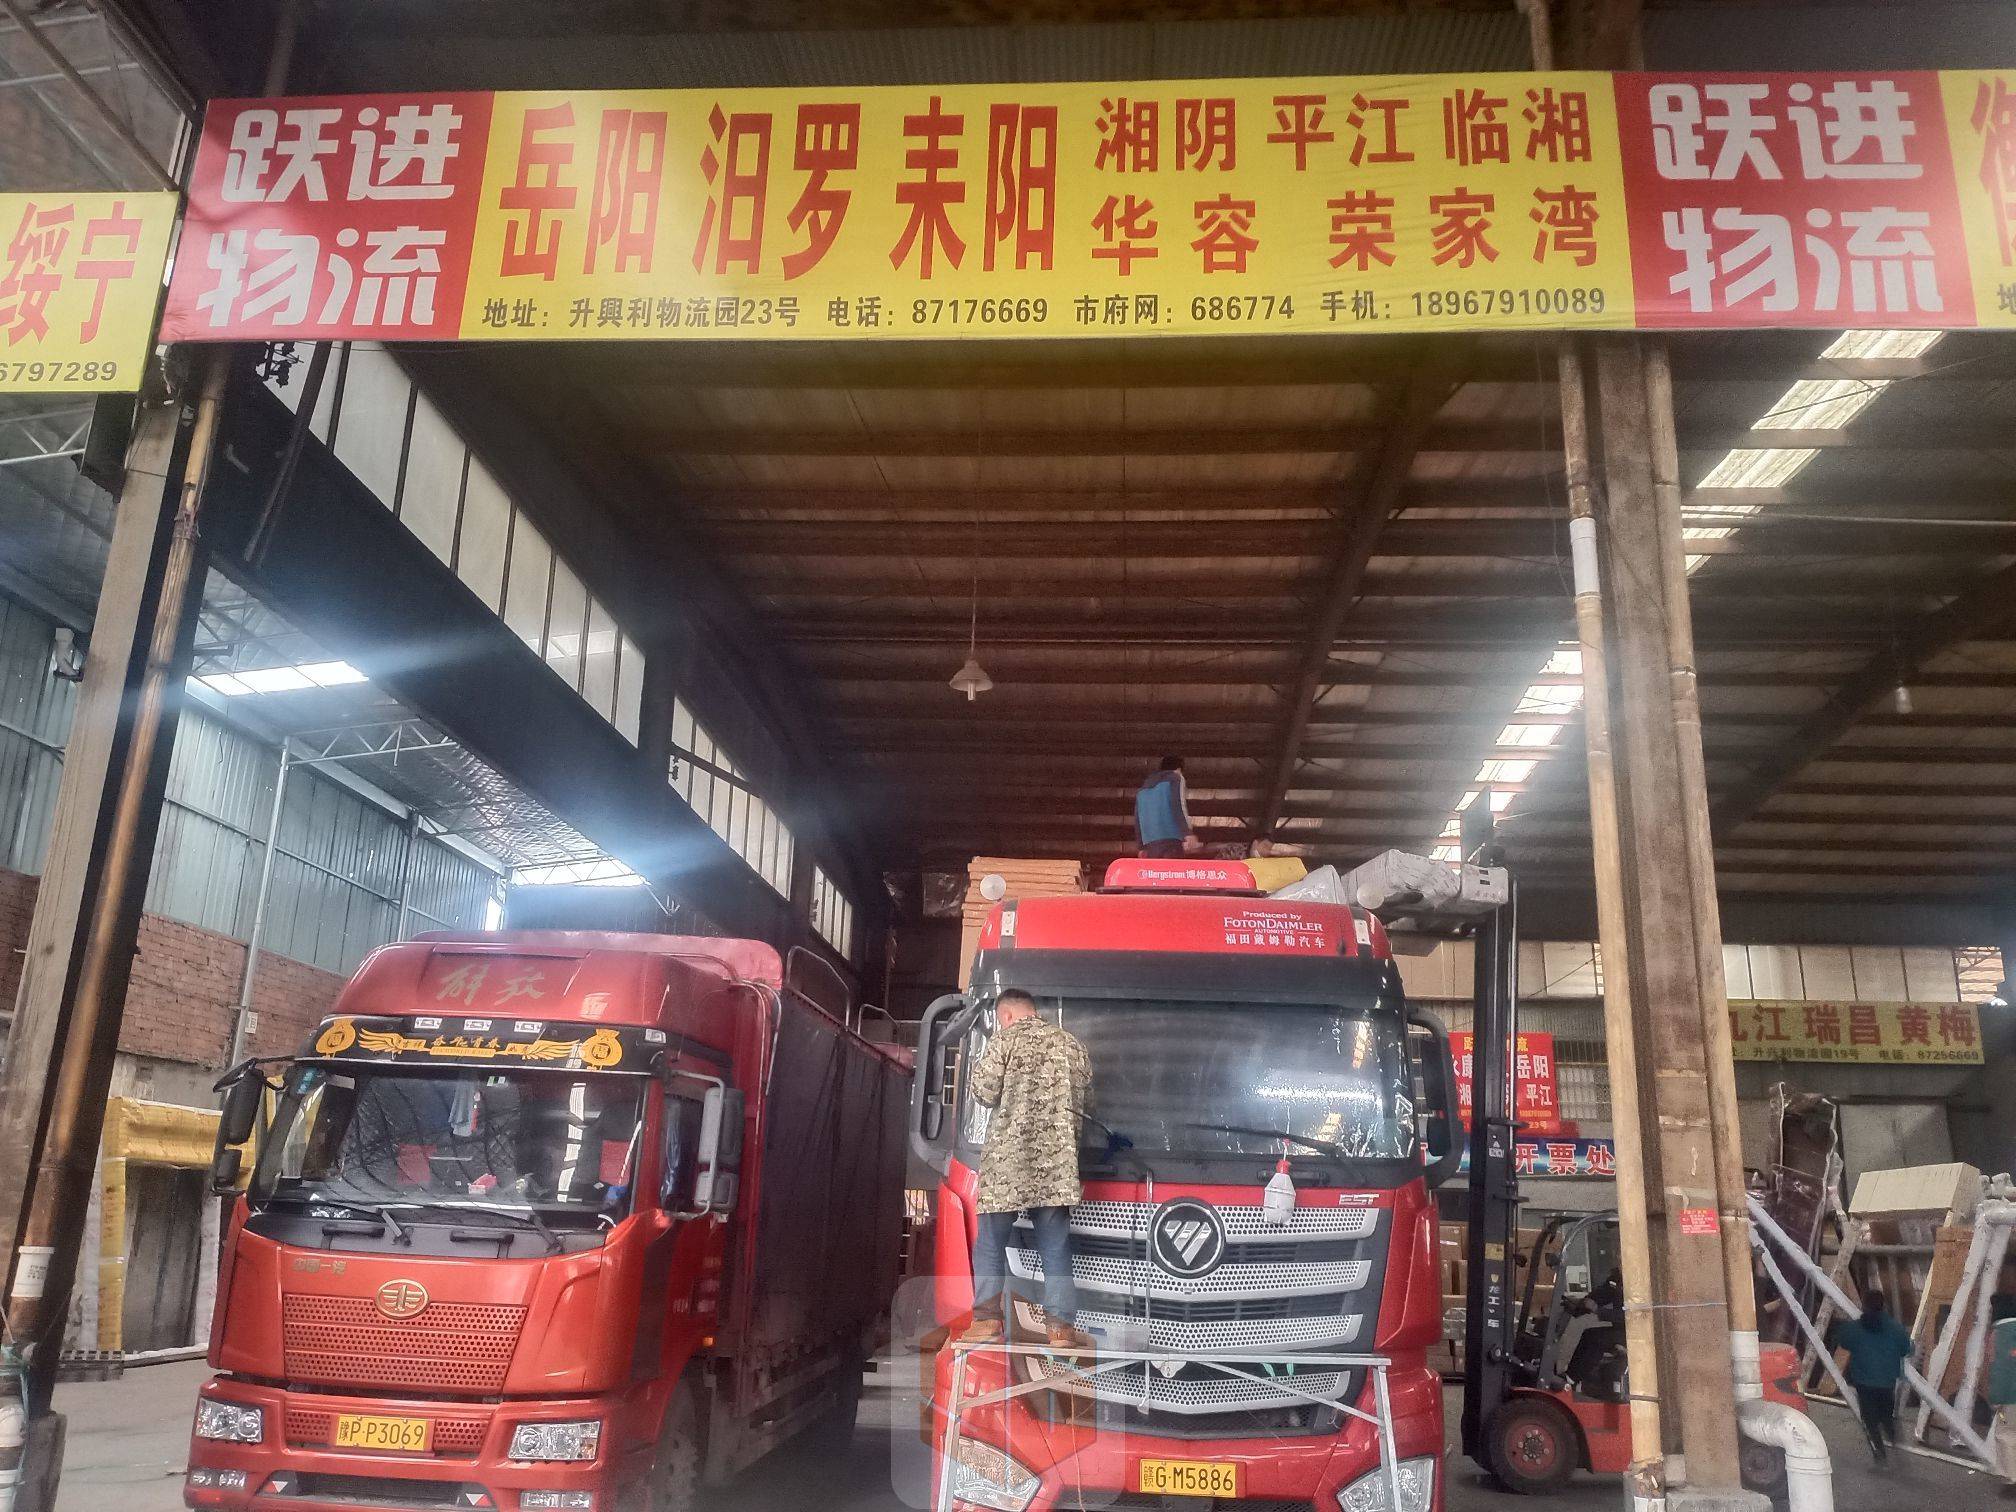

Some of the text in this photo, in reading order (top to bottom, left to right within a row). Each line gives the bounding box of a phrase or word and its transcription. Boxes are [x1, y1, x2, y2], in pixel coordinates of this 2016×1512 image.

[221, 104, 463, 203] 跃进
[1094, 87, 1592, 173] 湘阴 平江 临湘
[1649, 80, 1924, 180] 跃进
[499, 95, 1058, 281] 岳阳 汨罗 耒阳
[1091, 184, 1601, 276] 华容 荣家湾
[195, 225, 447, 327] 物流
[1662, 206, 1944, 313] 物流
[911, 297, 1049, 325] 87176669
[1190, 295, 1295, 321] 686774
[1411, 287, 1606, 317] 18967910089
[1224, 932, 1326, 949] 福田戴姆勒汽车
[1242, 910, 1302, 921] Produced by
[1803, 1003, 1882, 1046] 瑞昌
[1896, 1005, 1977, 1047] 黄梅
[1525, 1083, 1553, 1107] 平江
[1338, 1193, 1380, 1206] EST
